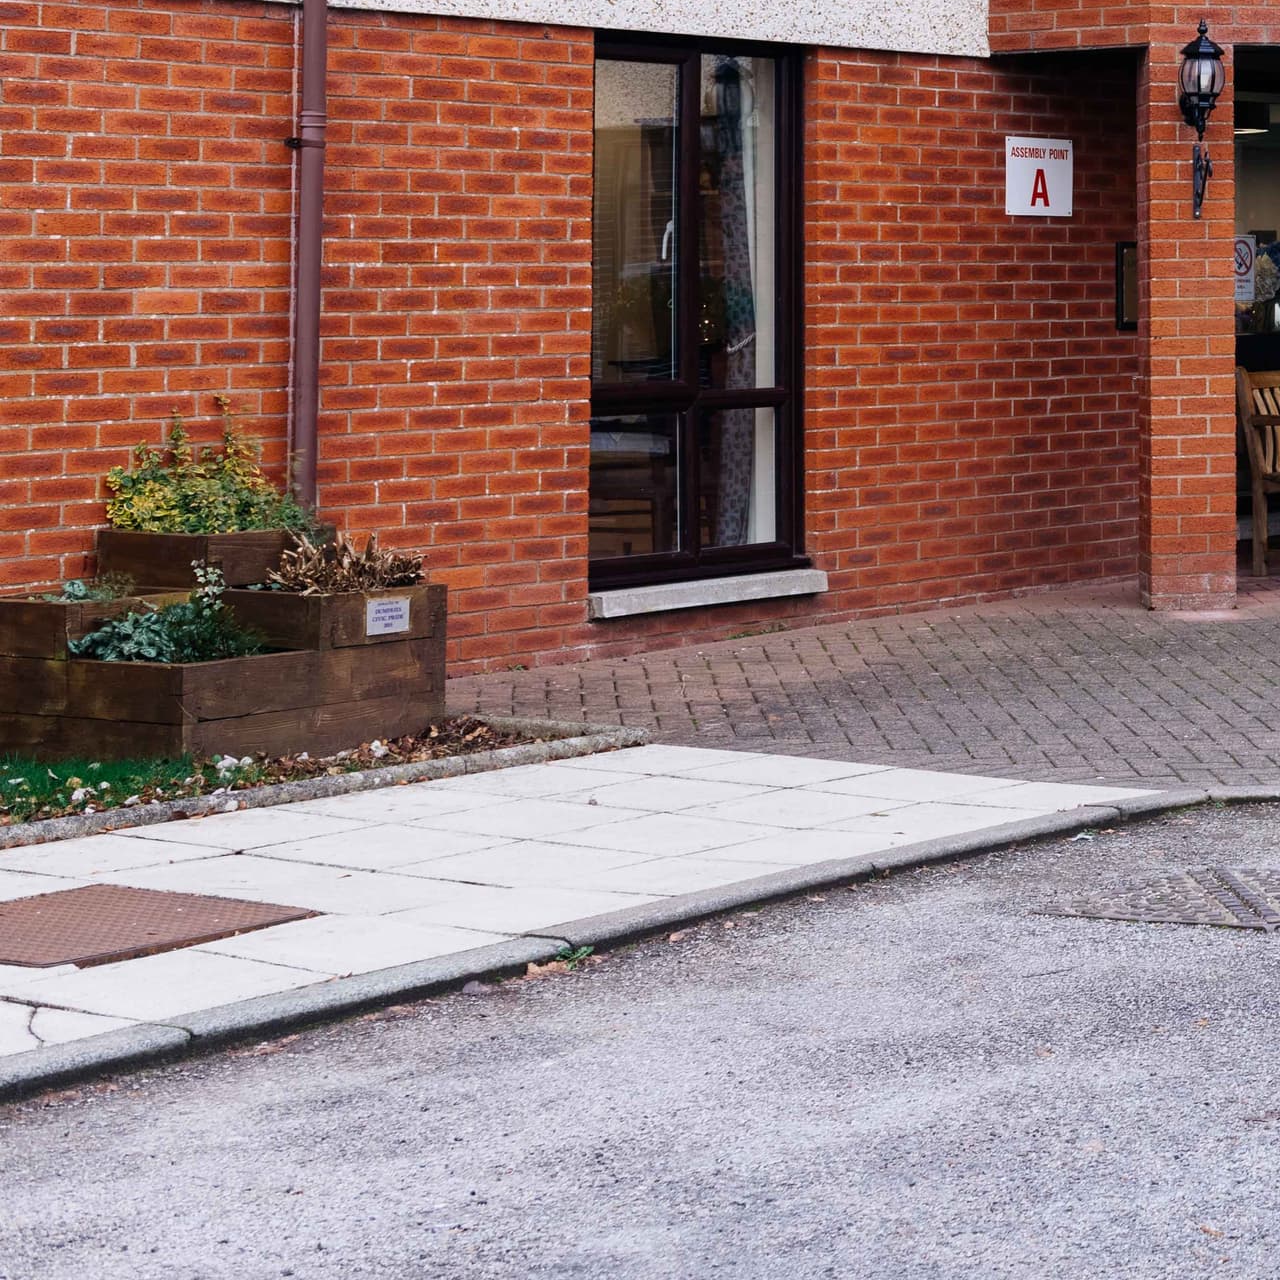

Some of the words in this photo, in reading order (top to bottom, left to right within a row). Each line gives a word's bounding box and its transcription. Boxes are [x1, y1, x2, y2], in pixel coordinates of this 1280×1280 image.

[1011, 146, 1046, 159] ASSEMBLY
[1049, 148, 1069, 160] POINT
[1030, 168, 1050, 207] A
